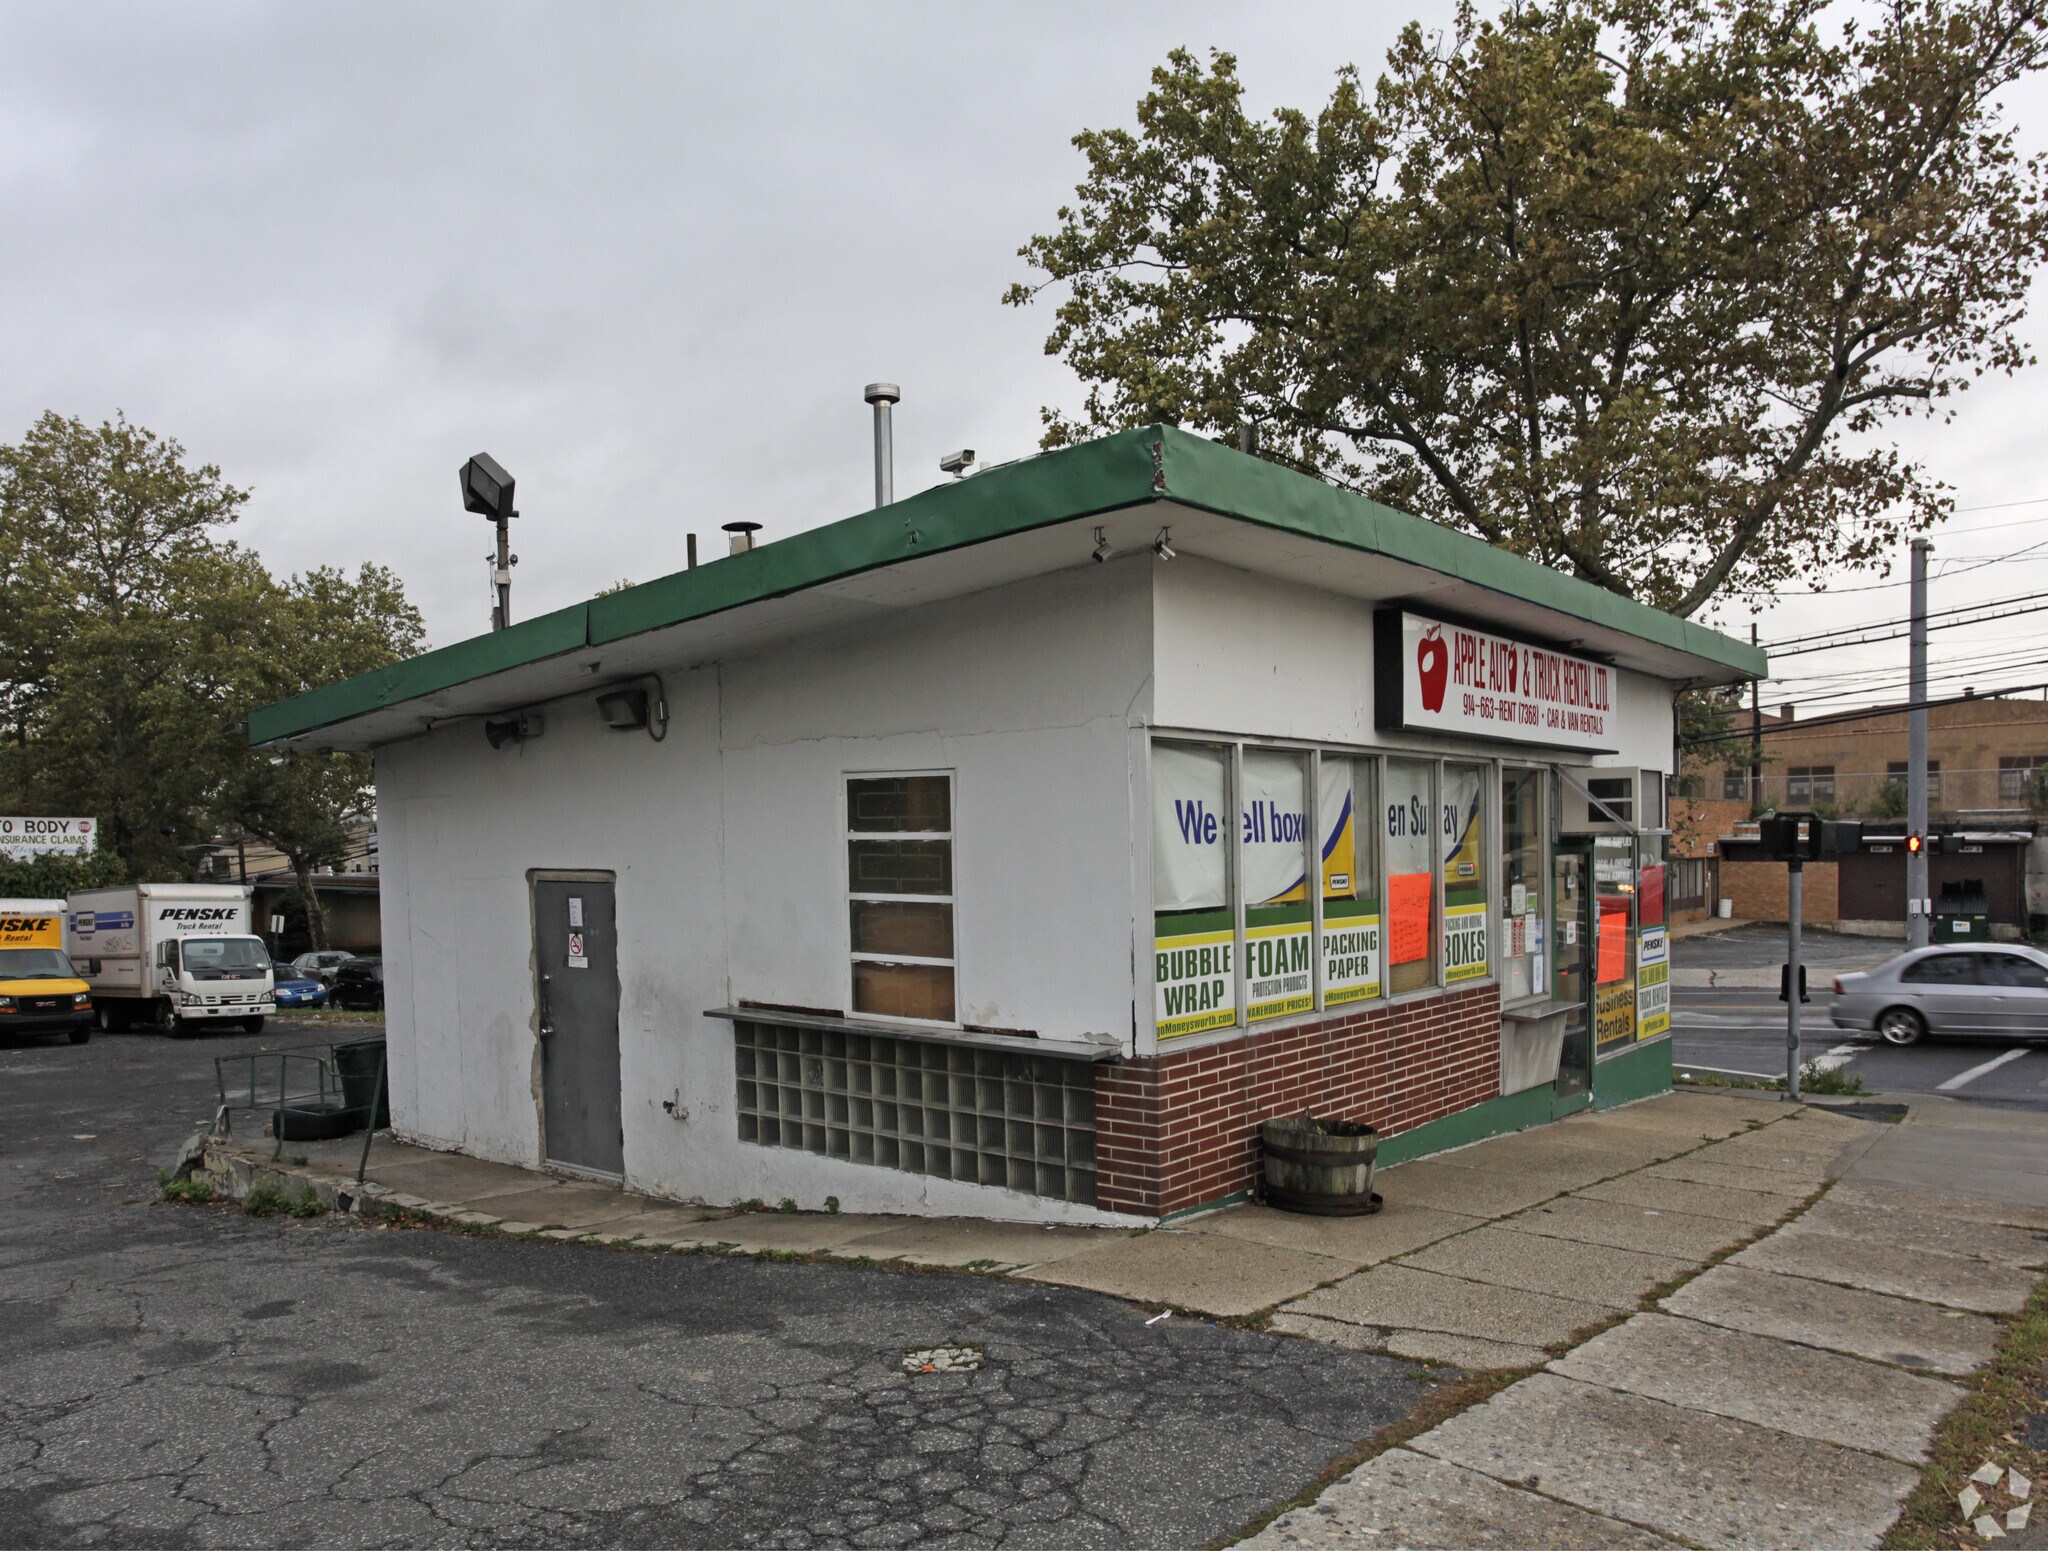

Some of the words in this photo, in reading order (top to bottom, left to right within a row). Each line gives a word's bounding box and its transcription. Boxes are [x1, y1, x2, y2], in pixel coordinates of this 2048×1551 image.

[1454, 631, 1486, 689] APPLE
[1523, 648, 1530, 698] &
[1533, 651, 1561, 704] TRUCK
[1564, 659, 1593, 709] RENTAL
[1595, 667, 1610, 712] LTD.
[1463, 693, 1517, 724] 914-663-RENT
[1518, 702, 1539, 727] (7368)
[1547, 707, 1559, 728] CAR
[1561, 710, 1566, 730] &
[1568, 711, 1579, 732] VAN
[1580, 714, 1604, 736] RENTALS
[25, 820, 70, 834] BODY
[1175, 799, 1218, 845] We
[50, 835, 88, 845] CLAIMS
[159, 908, 239, 921] PENSKE
[176, 922, 196, 931] Truck
[198, 922, 223, 931] Rental
[4, 934, 33, 942] Rental
[1322, 930, 1378, 957] PACKING
[1445, 929, 1486, 968] BOXES
[1643, 937, 1664, 951] PENSKE
[1155, 944, 1232, 983] BUBBLE
[1245, 935, 1310, 980] FOAM
[1328, 954, 1369, 981] PAPER
[1163, 979, 1225, 1017] WRAP
[1252, 978, 1282, 999] PROTECTION
[1283, 974, 1308, 993] PRODUCTS
[1324, 984, 1379, 1003] oMoneysworth.com
[1286, 996, 1312, 1012] PRICES!
[1597, 1011, 1630, 1041] Rentals
